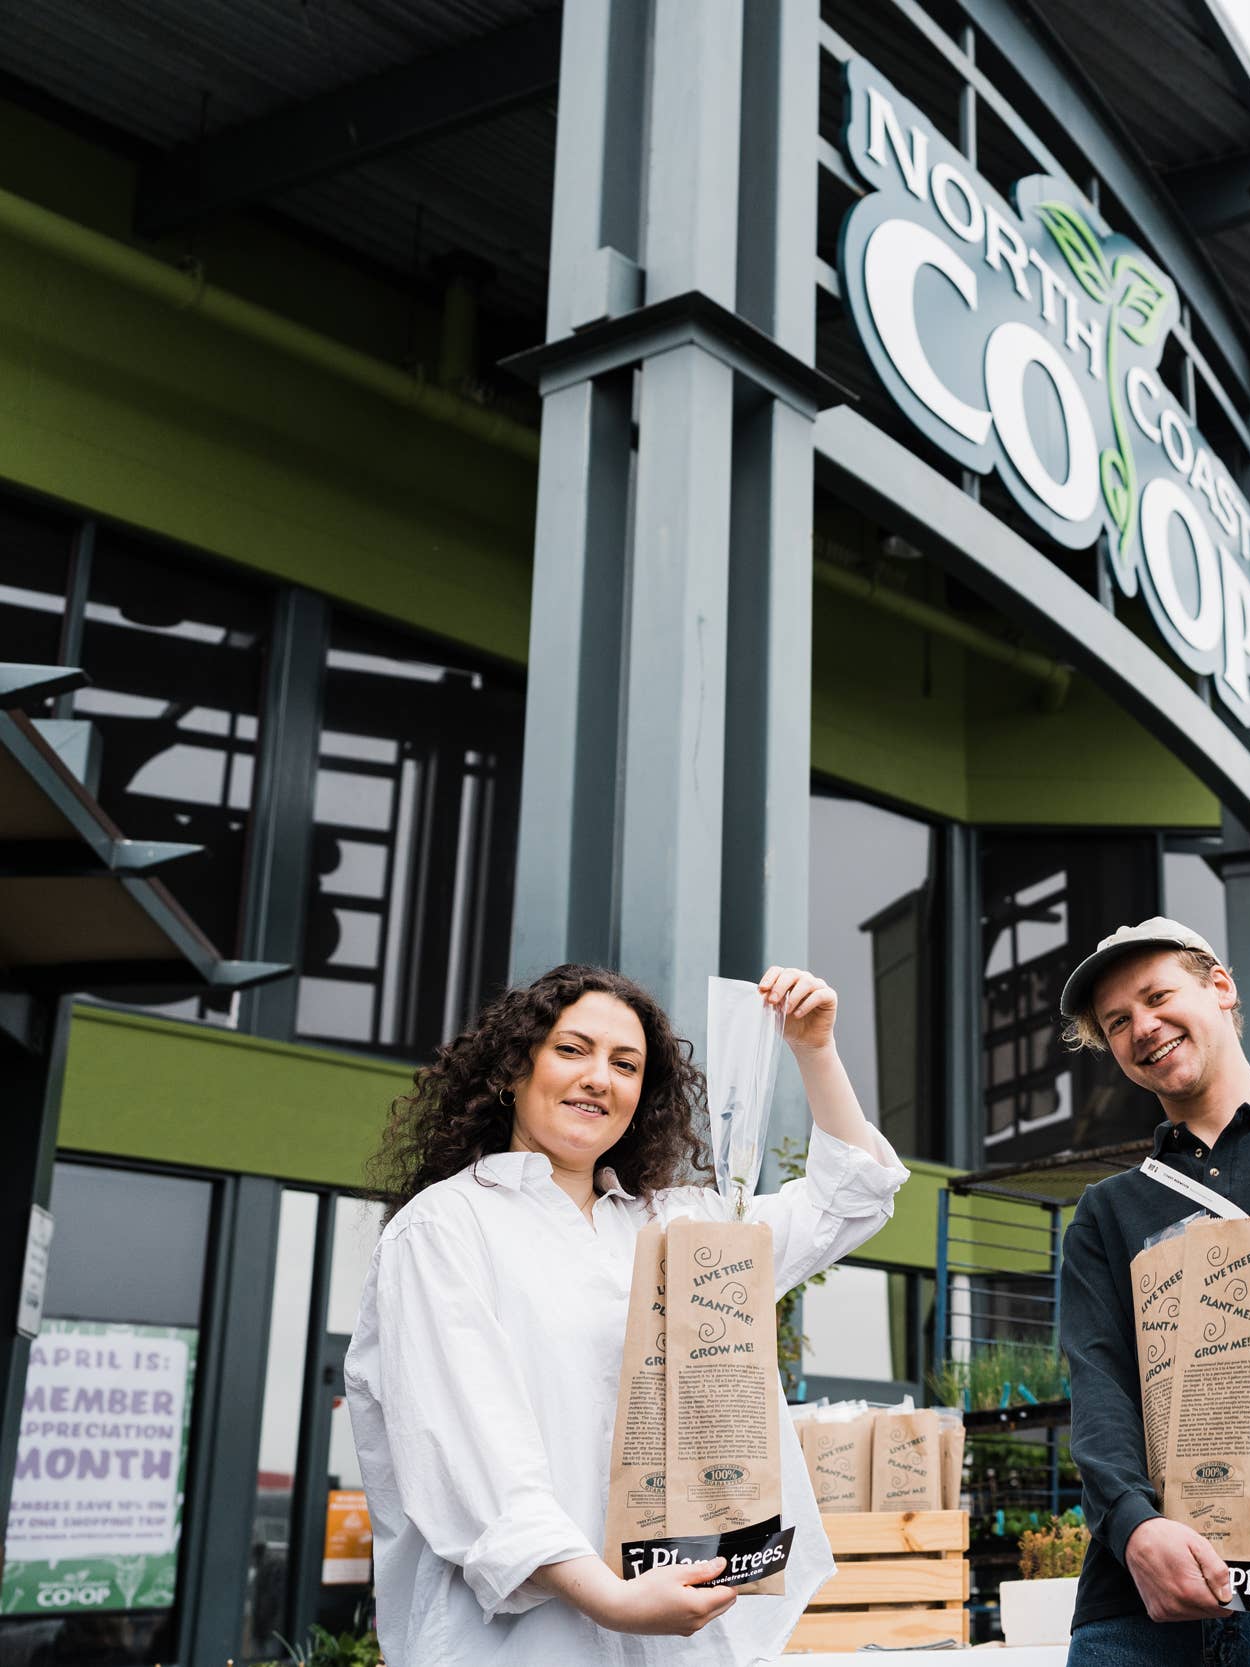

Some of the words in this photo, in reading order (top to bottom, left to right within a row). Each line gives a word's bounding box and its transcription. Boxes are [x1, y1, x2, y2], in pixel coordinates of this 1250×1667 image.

[867, 87, 1104, 379] NORTH
[692, 1270, 722, 1288] LIVE
[720, 1258, 754, 1277] TREE!
[1204, 1269, 1227, 1287] LIVE
[690, 1294, 735, 1315] PLANT
[734, 1309, 755, 1326] ME!
[1141, 1291, 1159, 1314] LIVE
[1200, 1294, 1234, 1315] PLANT
[1142, 1321, 1170, 1332] PLANT
[690, 1344, 731, 1360] GROW
[733, 1342, 754, 1353] ME!
[1194, 1341, 1229, 1359] GROW
[1230, 1336, 1250, 1350] ME!
[29, 1348, 122, 1369] APRIL
[134, 1351, 171, 1371] IS:
[23, 1386, 174, 1416] MEMBER
[20, 1421, 174, 1440] PPRECIATION
[889, 1443, 906, 1455] LIVE
[14, 1447, 173, 1480] MONTH
[816, 1465, 841, 1477] PLANT
[888, 1458, 913, 1472] PLANT
[1202, 1467, 1224, 1478] 100%
[710, 1469, 738, 1481] 100%
[886, 1488, 911, 1498] GROW
[730, 1543, 786, 1574] trees.
